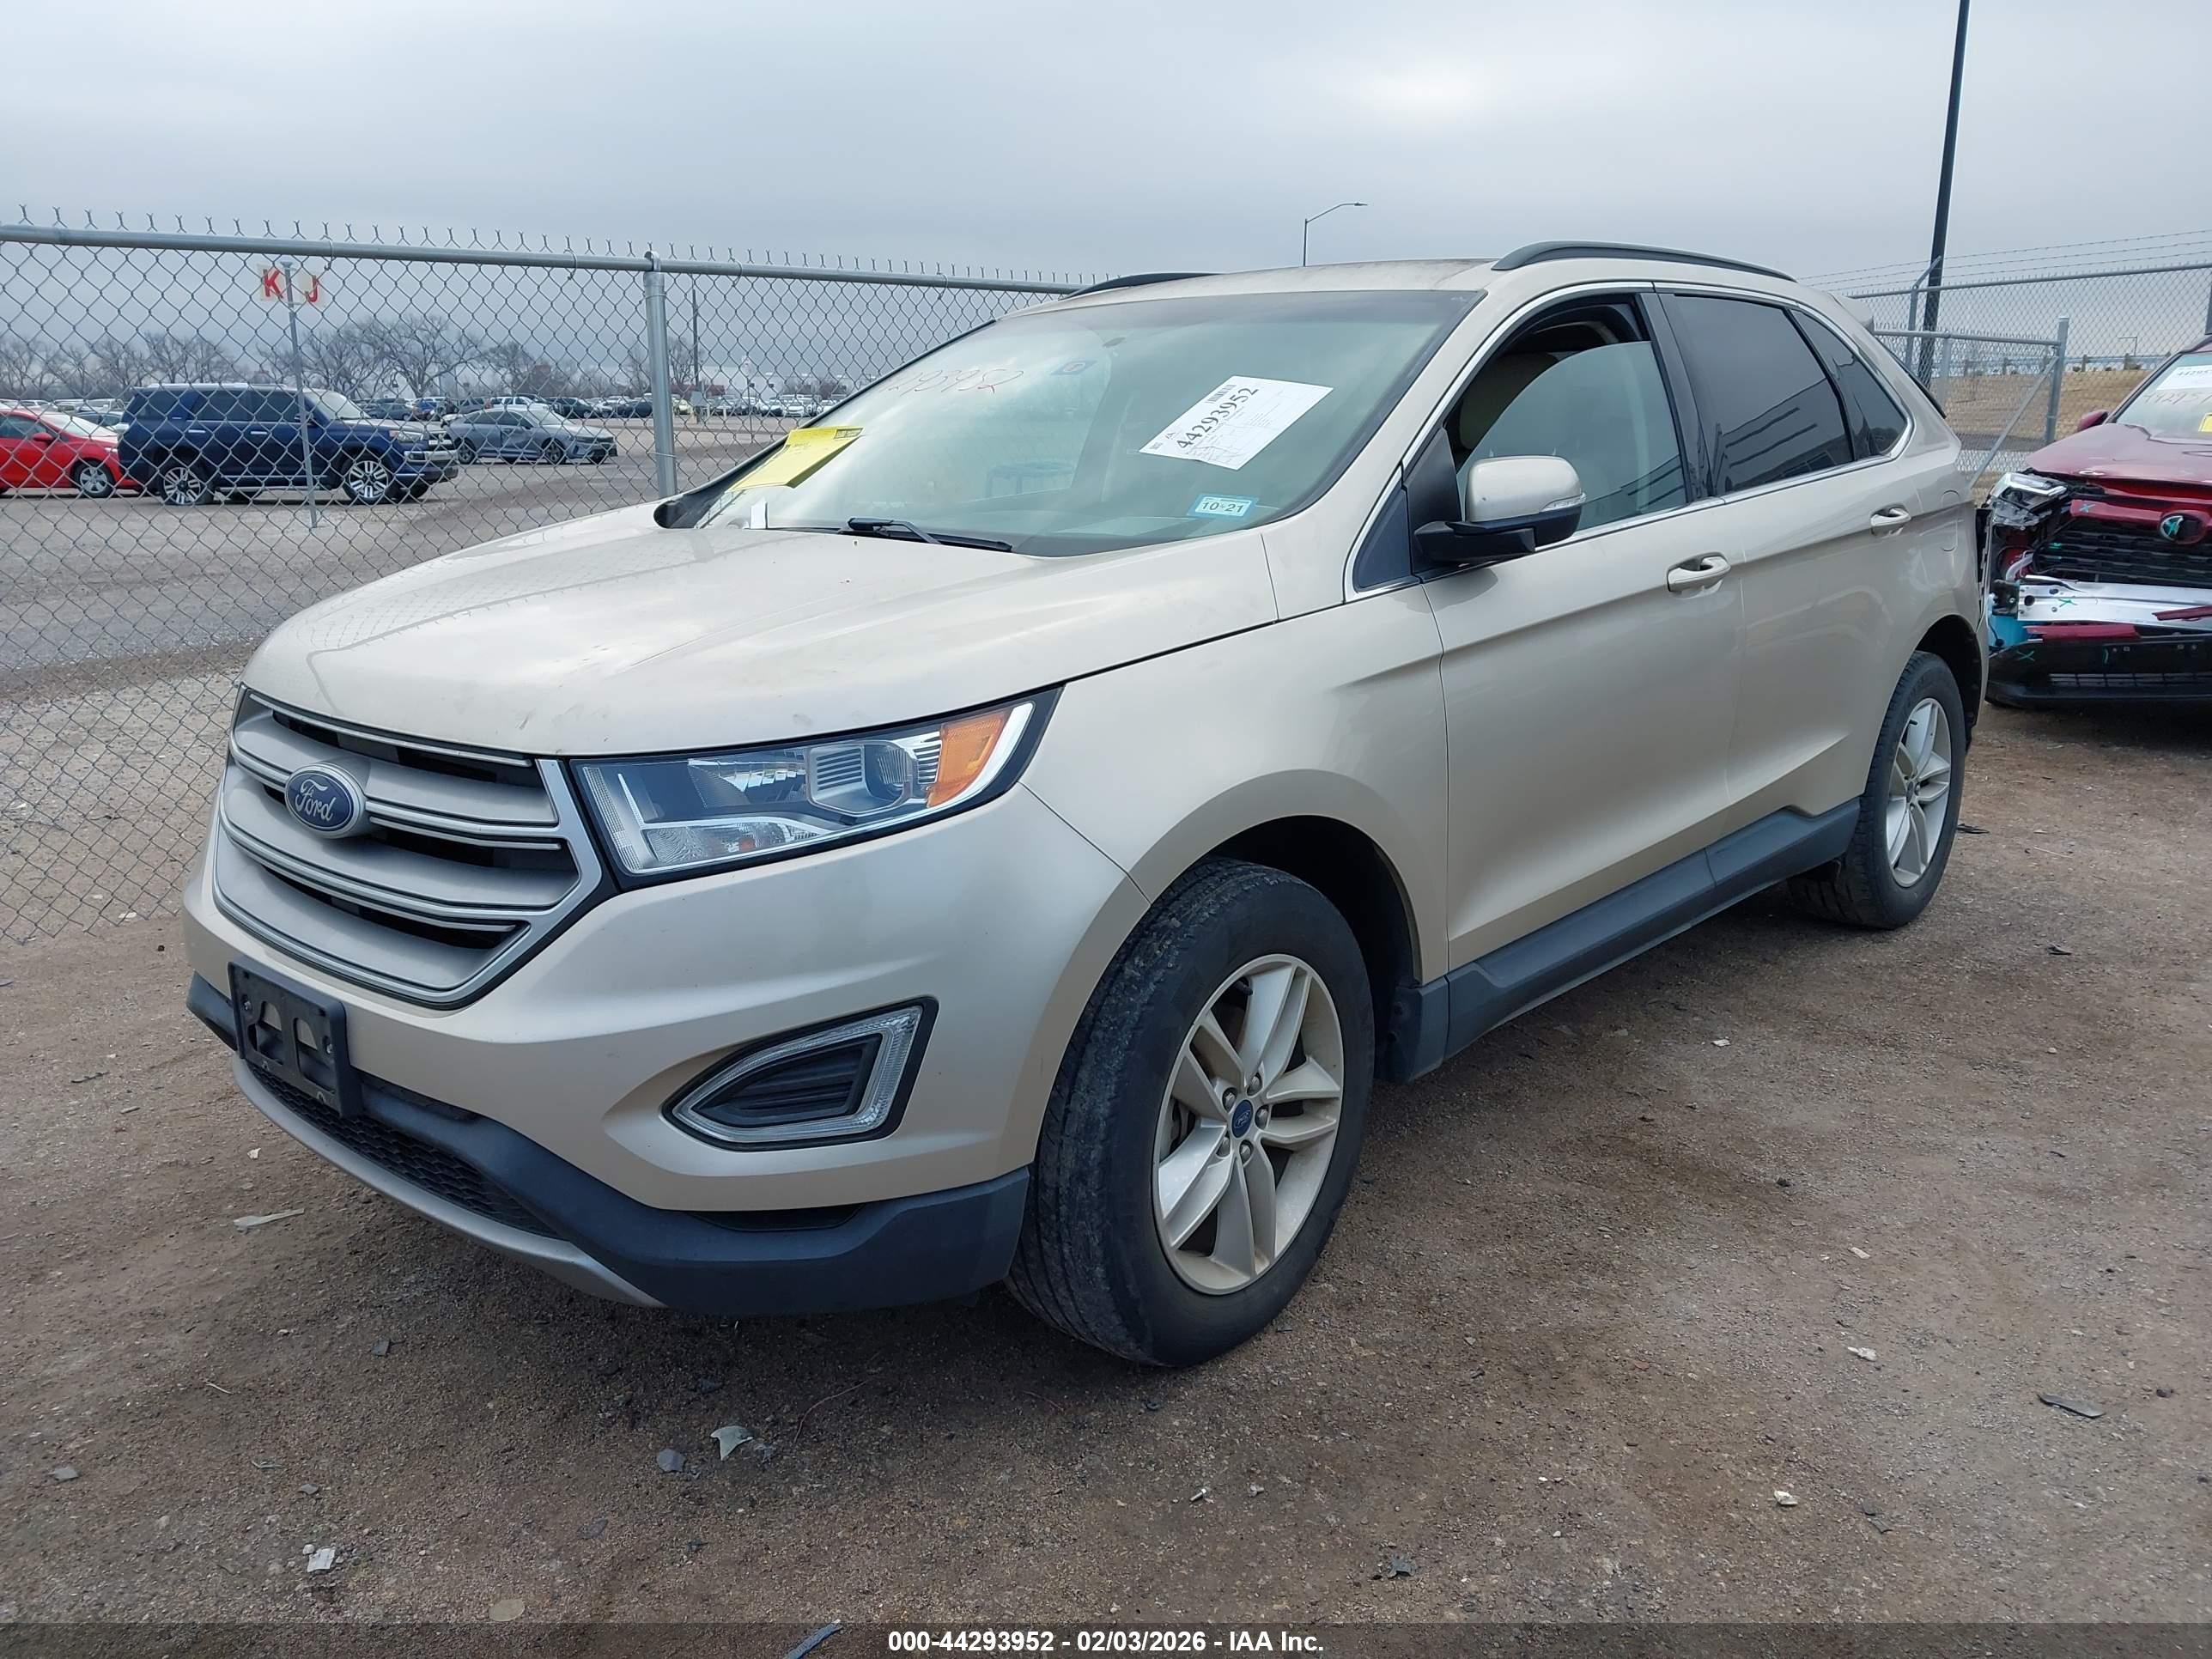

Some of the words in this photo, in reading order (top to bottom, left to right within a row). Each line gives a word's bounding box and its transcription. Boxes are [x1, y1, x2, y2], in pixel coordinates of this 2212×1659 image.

[263, 269, 283, 298] K
[305, 275, 317, 302] J
[1176, 387, 1260, 448] 44293952
[295, 779, 337, 822] Ford
